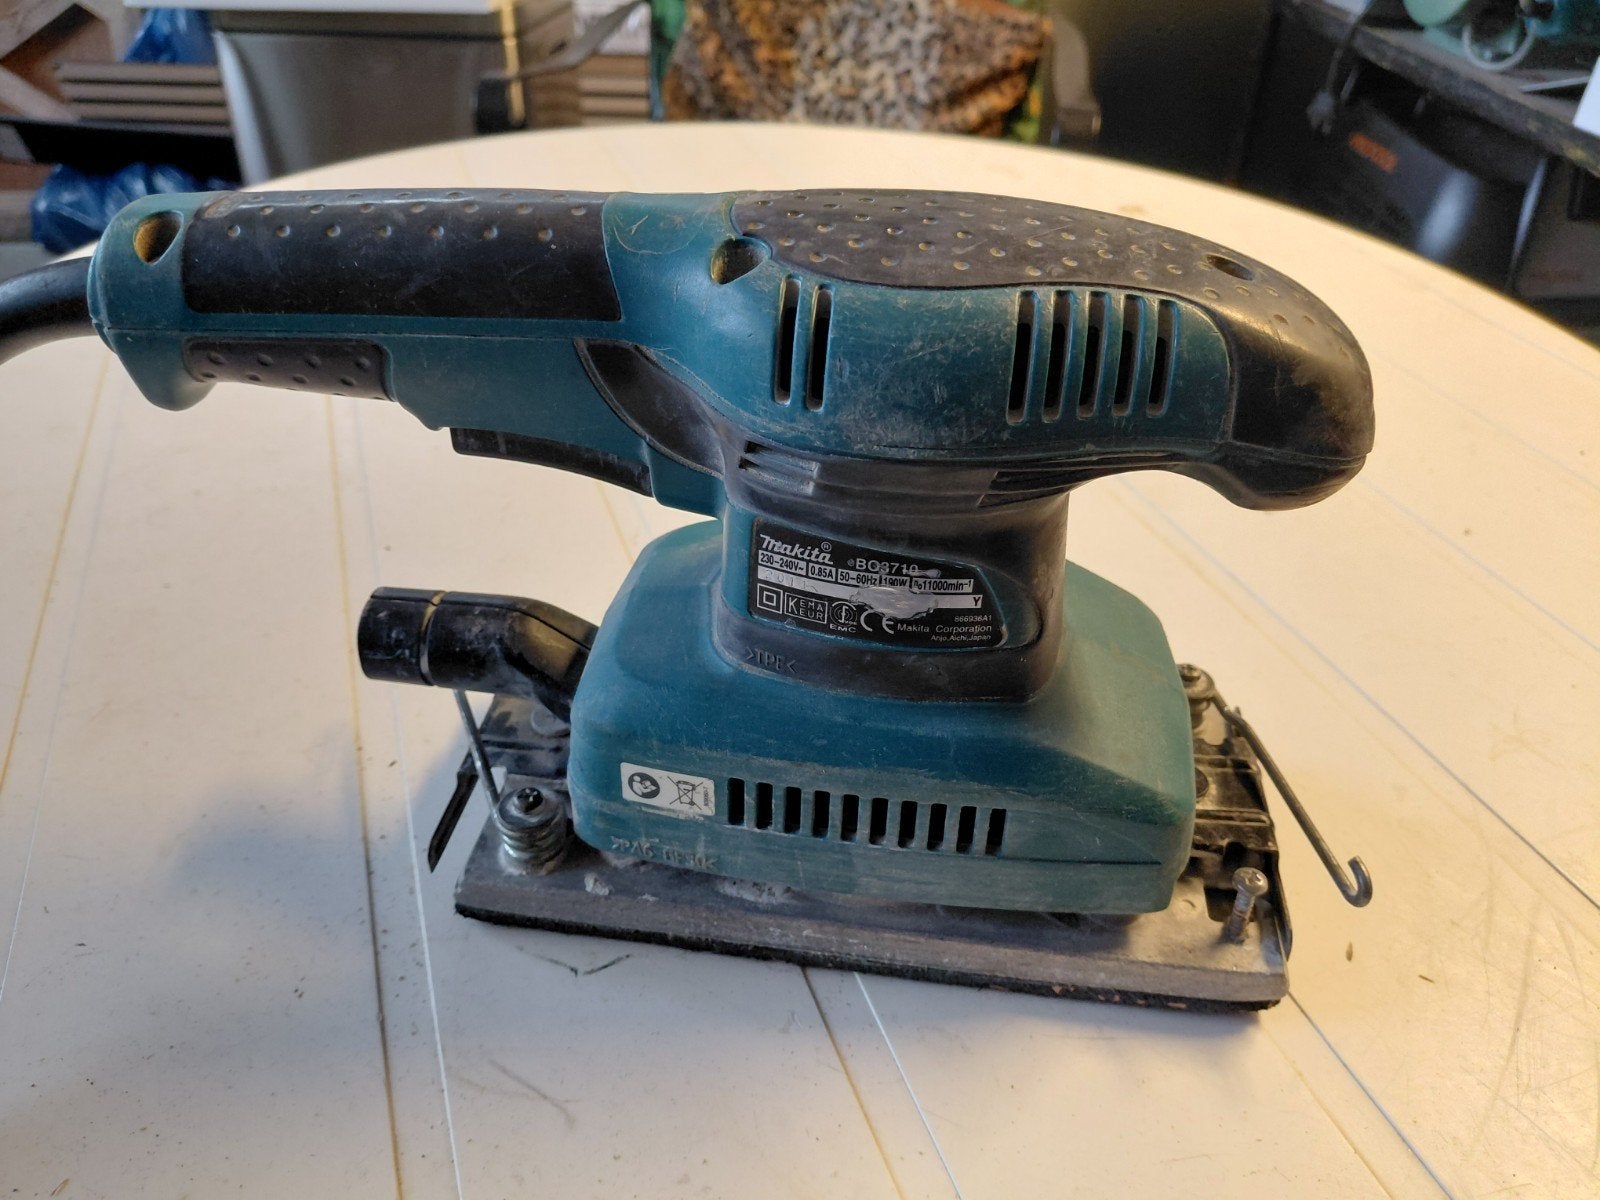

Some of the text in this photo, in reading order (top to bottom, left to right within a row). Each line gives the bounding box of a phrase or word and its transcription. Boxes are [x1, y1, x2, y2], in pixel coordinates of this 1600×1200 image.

[810, 565, 833, 580] 0.85A
[839, 571, 878, 586] 50-60Hz
[884, 578, 907, 587] 190W
[973, 596, 981, 606] Y
[829, 624, 857, 633] EMC
[897, 623, 992, 635] Makita Corporation
